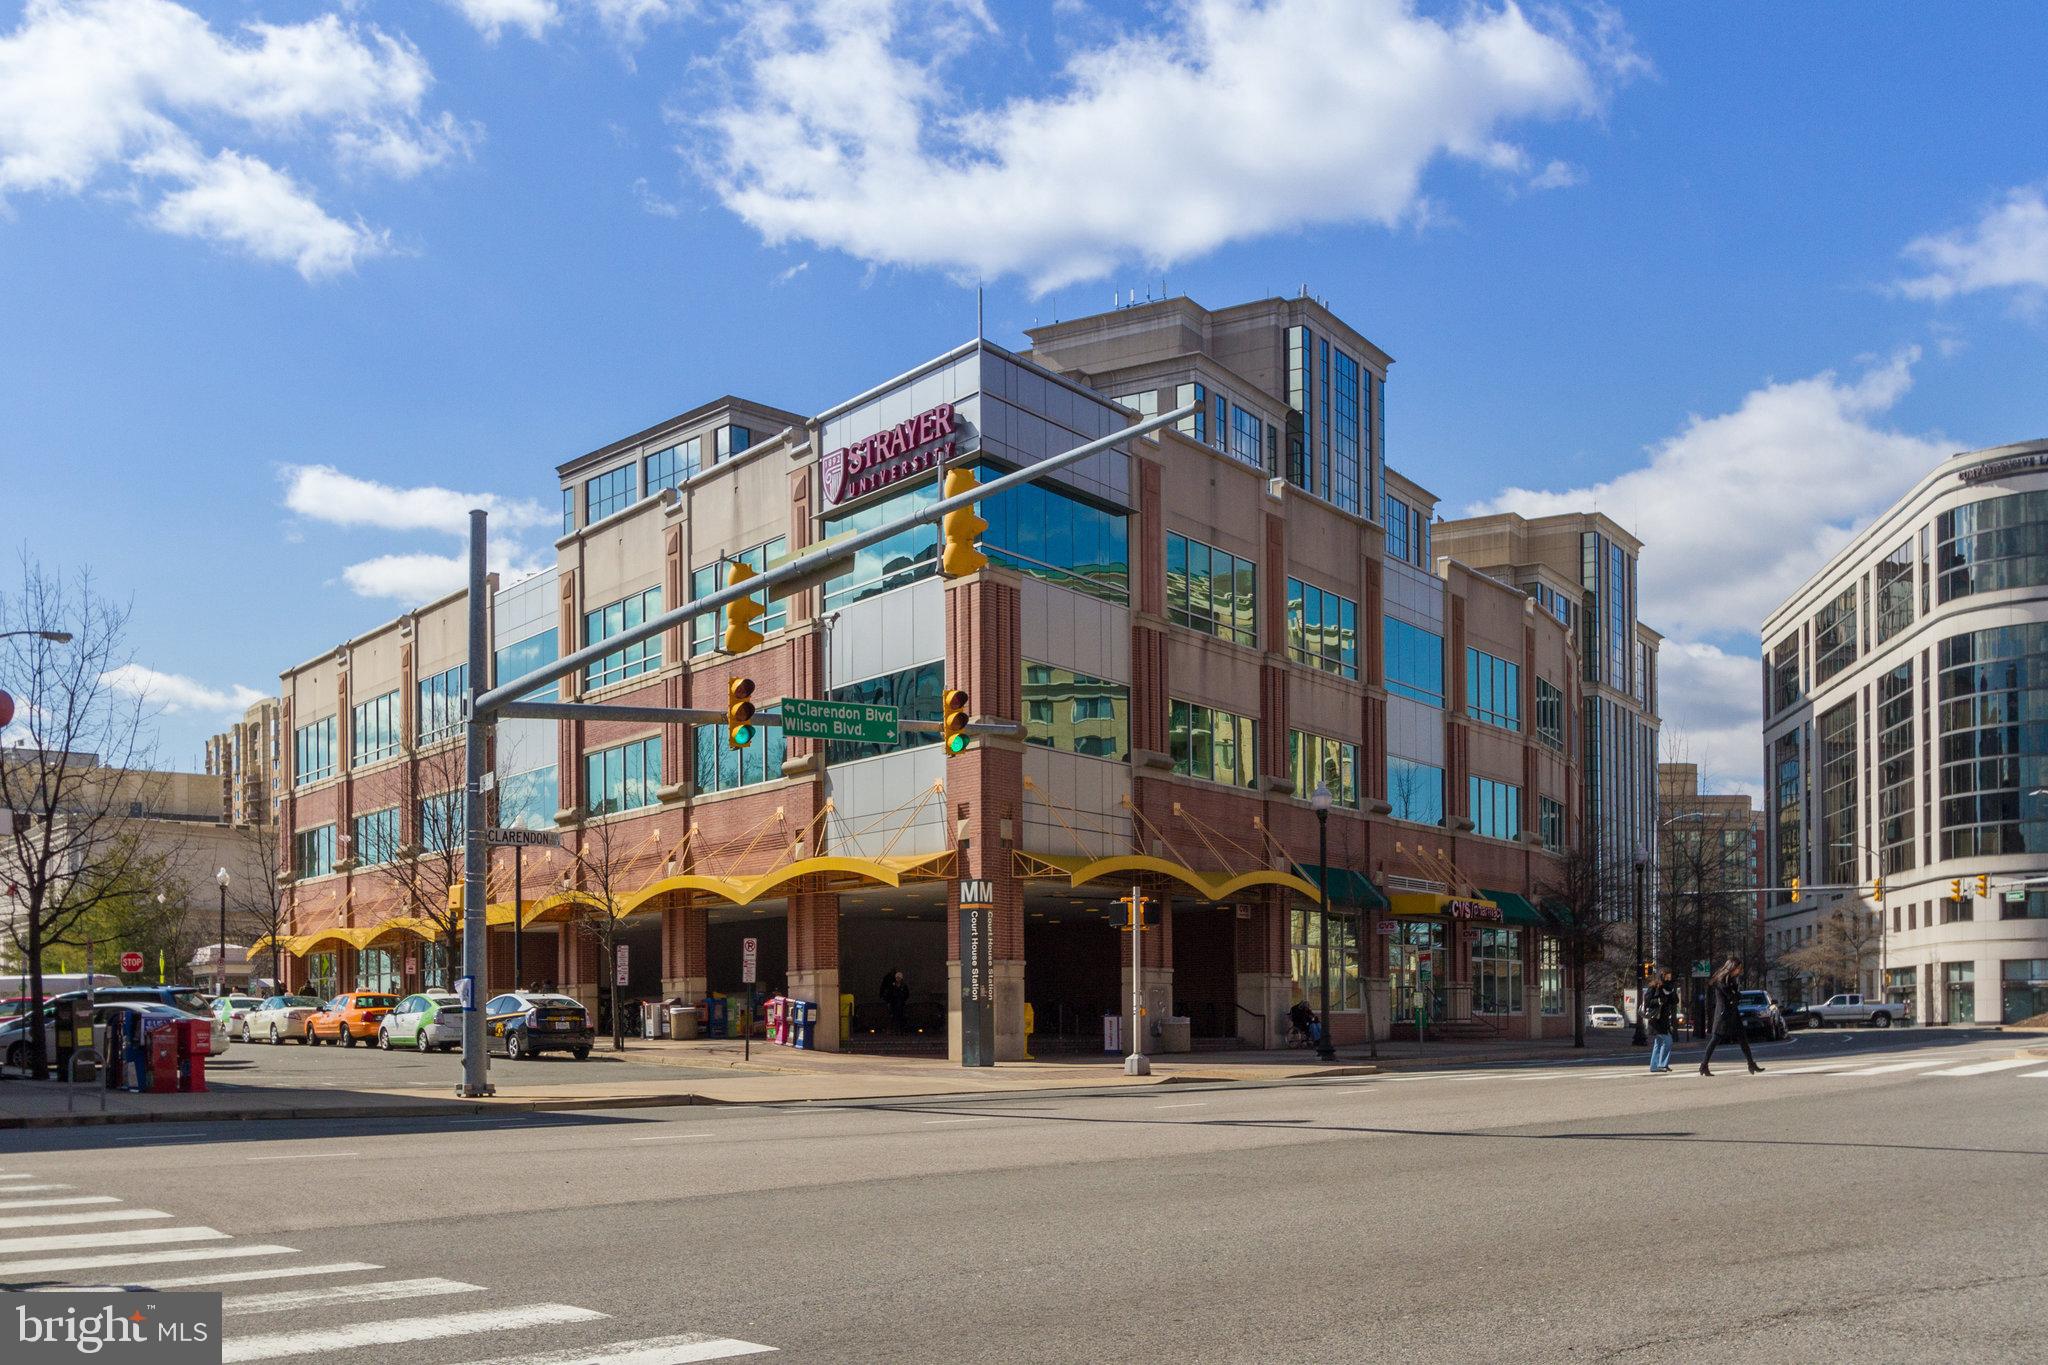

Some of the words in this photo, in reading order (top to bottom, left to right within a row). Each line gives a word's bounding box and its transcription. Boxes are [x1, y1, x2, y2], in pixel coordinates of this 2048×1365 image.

[848, 403, 954, 475] STRAYER
[824, 456, 841, 469] 1892
[850, 442, 955, 496] UNIVERSITY
[797, 703, 860, 720] Clarendon
[865, 708, 896, 723] Blvd.
[784, 717, 828, 733] Wilson
[833, 721, 866, 737] Blvd.
[487, 830, 549, 845] CLARENDON
[961, 881, 979, 903] M
[980, 881, 993, 903] M
[971, 911, 979, 936] Court
[122, 958, 142, 967] STOP
[971, 938, 979, 966] House
